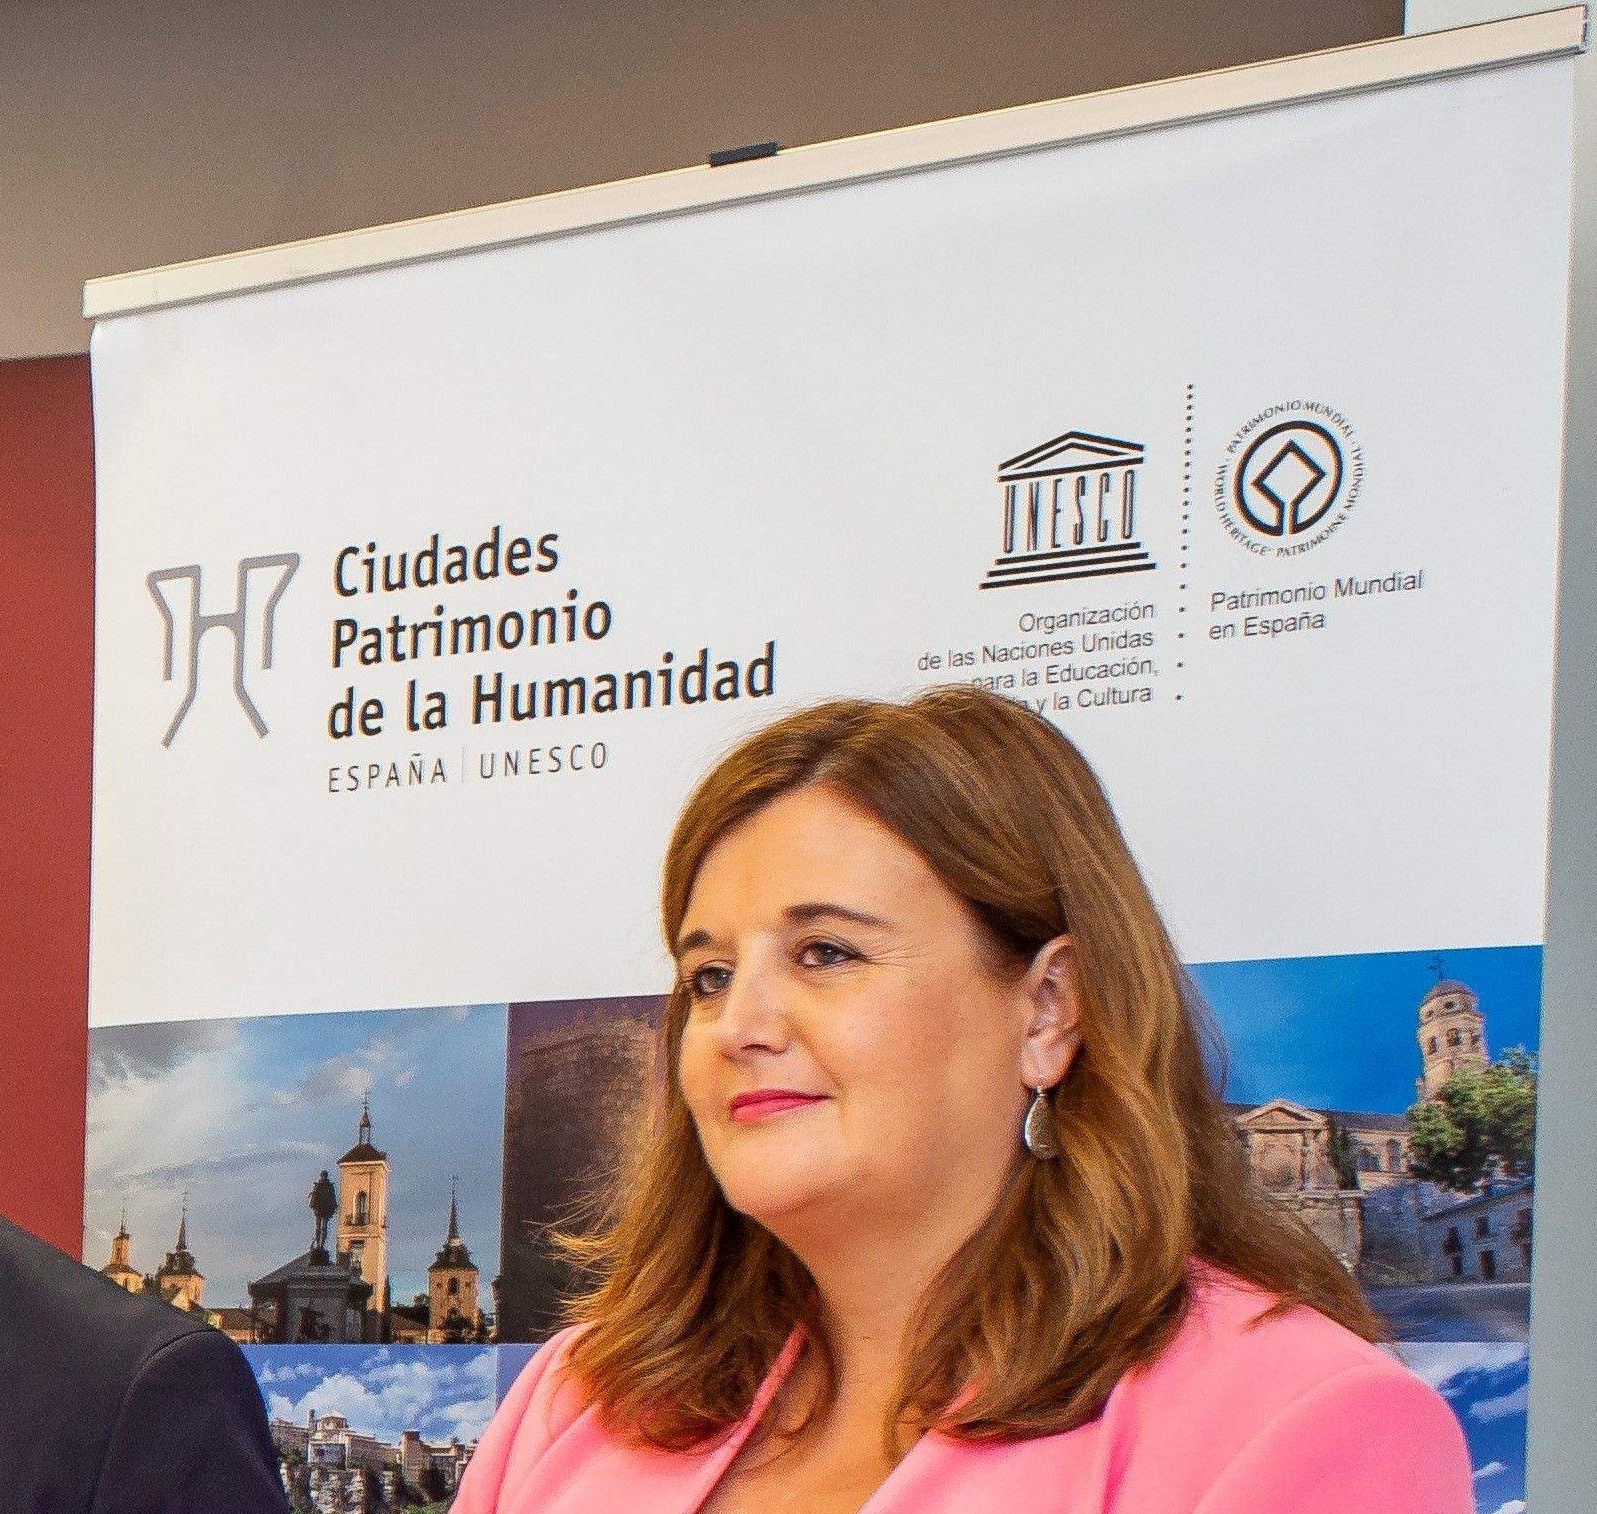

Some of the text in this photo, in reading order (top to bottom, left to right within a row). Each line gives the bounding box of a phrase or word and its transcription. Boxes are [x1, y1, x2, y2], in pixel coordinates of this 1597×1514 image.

[1003, 468, 1135, 553] UNESCO
[333, 524, 560, 598] Ciudades
[1210, 570, 1426, 612] Patrimonio Mundial
[331, 588, 613, 669] Patrimonio
[1018, 601, 1155, 634] Organización
[1209, 612, 1326, 641] en España
[917, 630, 1154, 671] de las Naciones Unidas
[328, 640, 776, 739] de la Humanidad
[1021, 669, 1038, 687] la
[1046, 657, 1160, 684] Educación,
[1053, 691, 1070, 711] la
[1077, 686, 1152, 708] Cultura
[328, 742, 607, 793] ESPAÑA UNESCO
